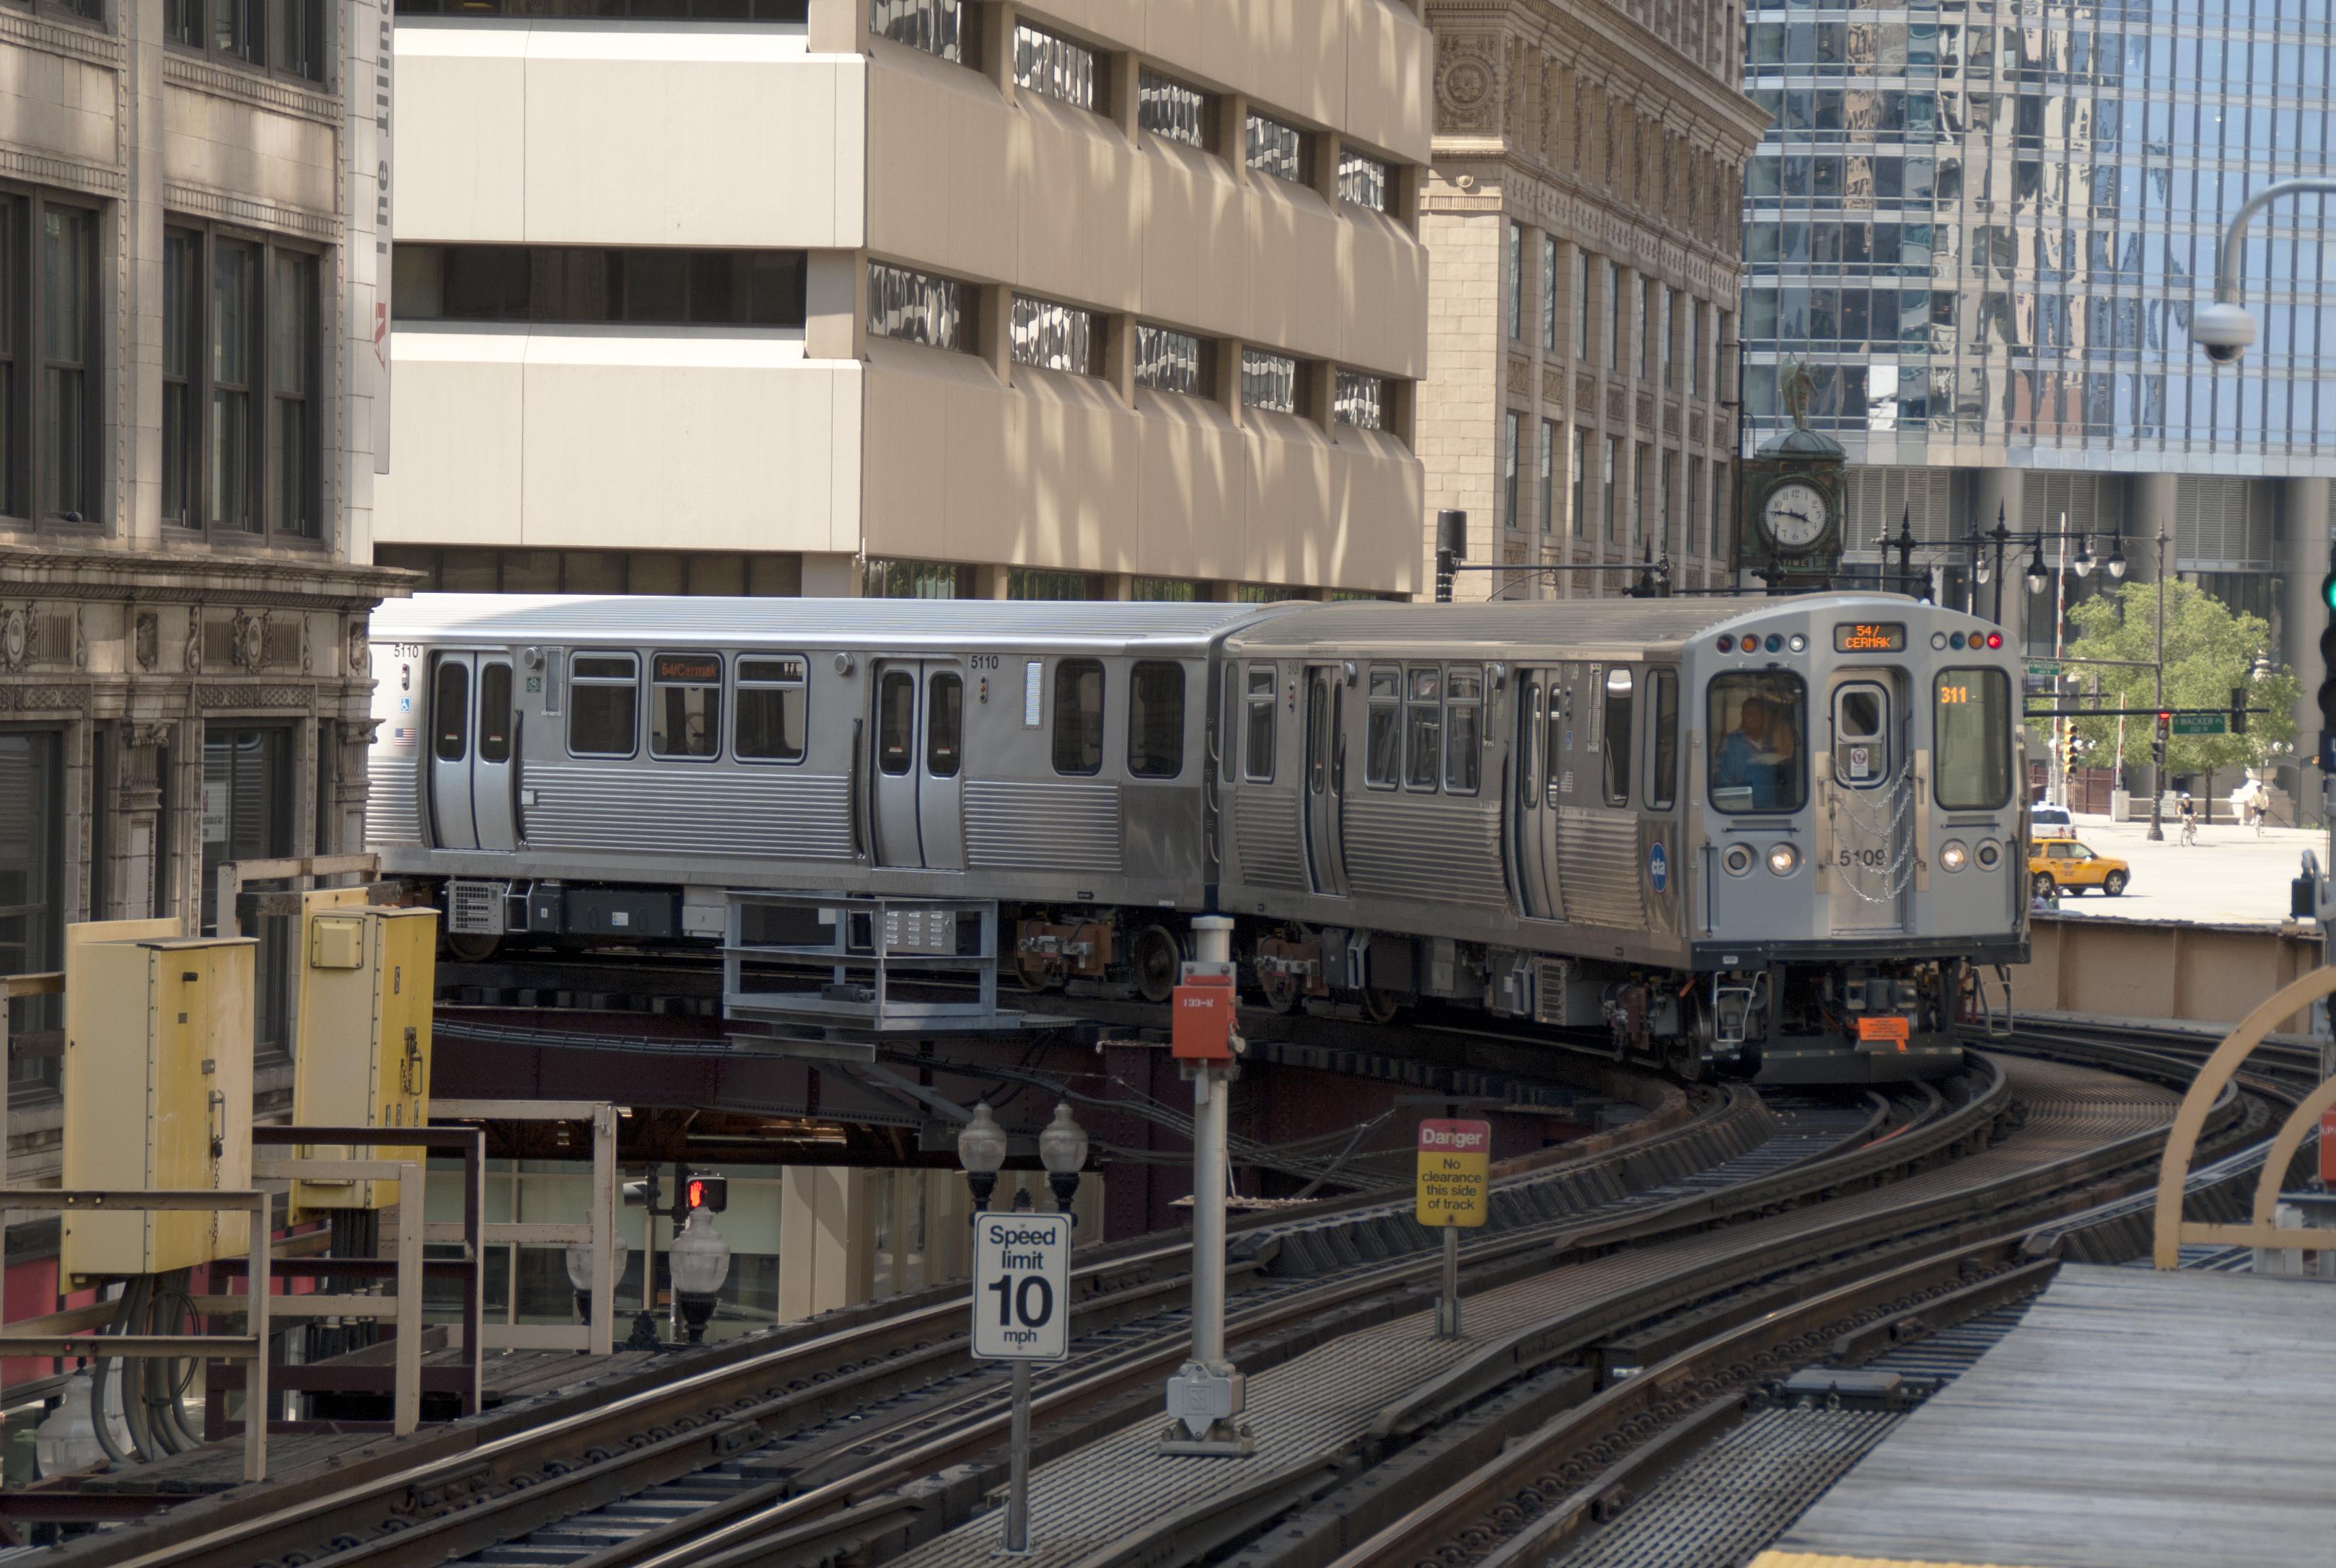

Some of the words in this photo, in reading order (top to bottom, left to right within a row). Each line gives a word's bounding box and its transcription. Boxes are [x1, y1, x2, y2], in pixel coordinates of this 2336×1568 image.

[1856, 625, 1880, 636] 54/
[1845, 637, 1891, 648] CERMAK
[394, 645, 418, 658] 5110
[661, 661, 716, 677] 54/Cermak
[971, 655, 999, 669] 5110
[1940, 686, 1967, 704] 311
[2180, 717, 2213, 726] WACKER
[1840, 849, 1885, 866] 5109
[1651, 858, 1666, 875] cta
[1422, 1128, 1483, 1148] Danger
[1443, 1158, 1461, 1170] No
[1422, 1171, 1482, 1184] clearance
[1427, 1185, 1449, 1196] this
[1452, 1185, 1477, 1197] side
[1428, 1198, 1441, 1210] of
[1444, 1199, 1475, 1210] track
[989, 1225, 1056, 1249] Speed
[1001, 1251, 1044, 1270] limit
[988, 1274, 1053, 1329] 10
[1004, 1329, 1037, 1344] mph
